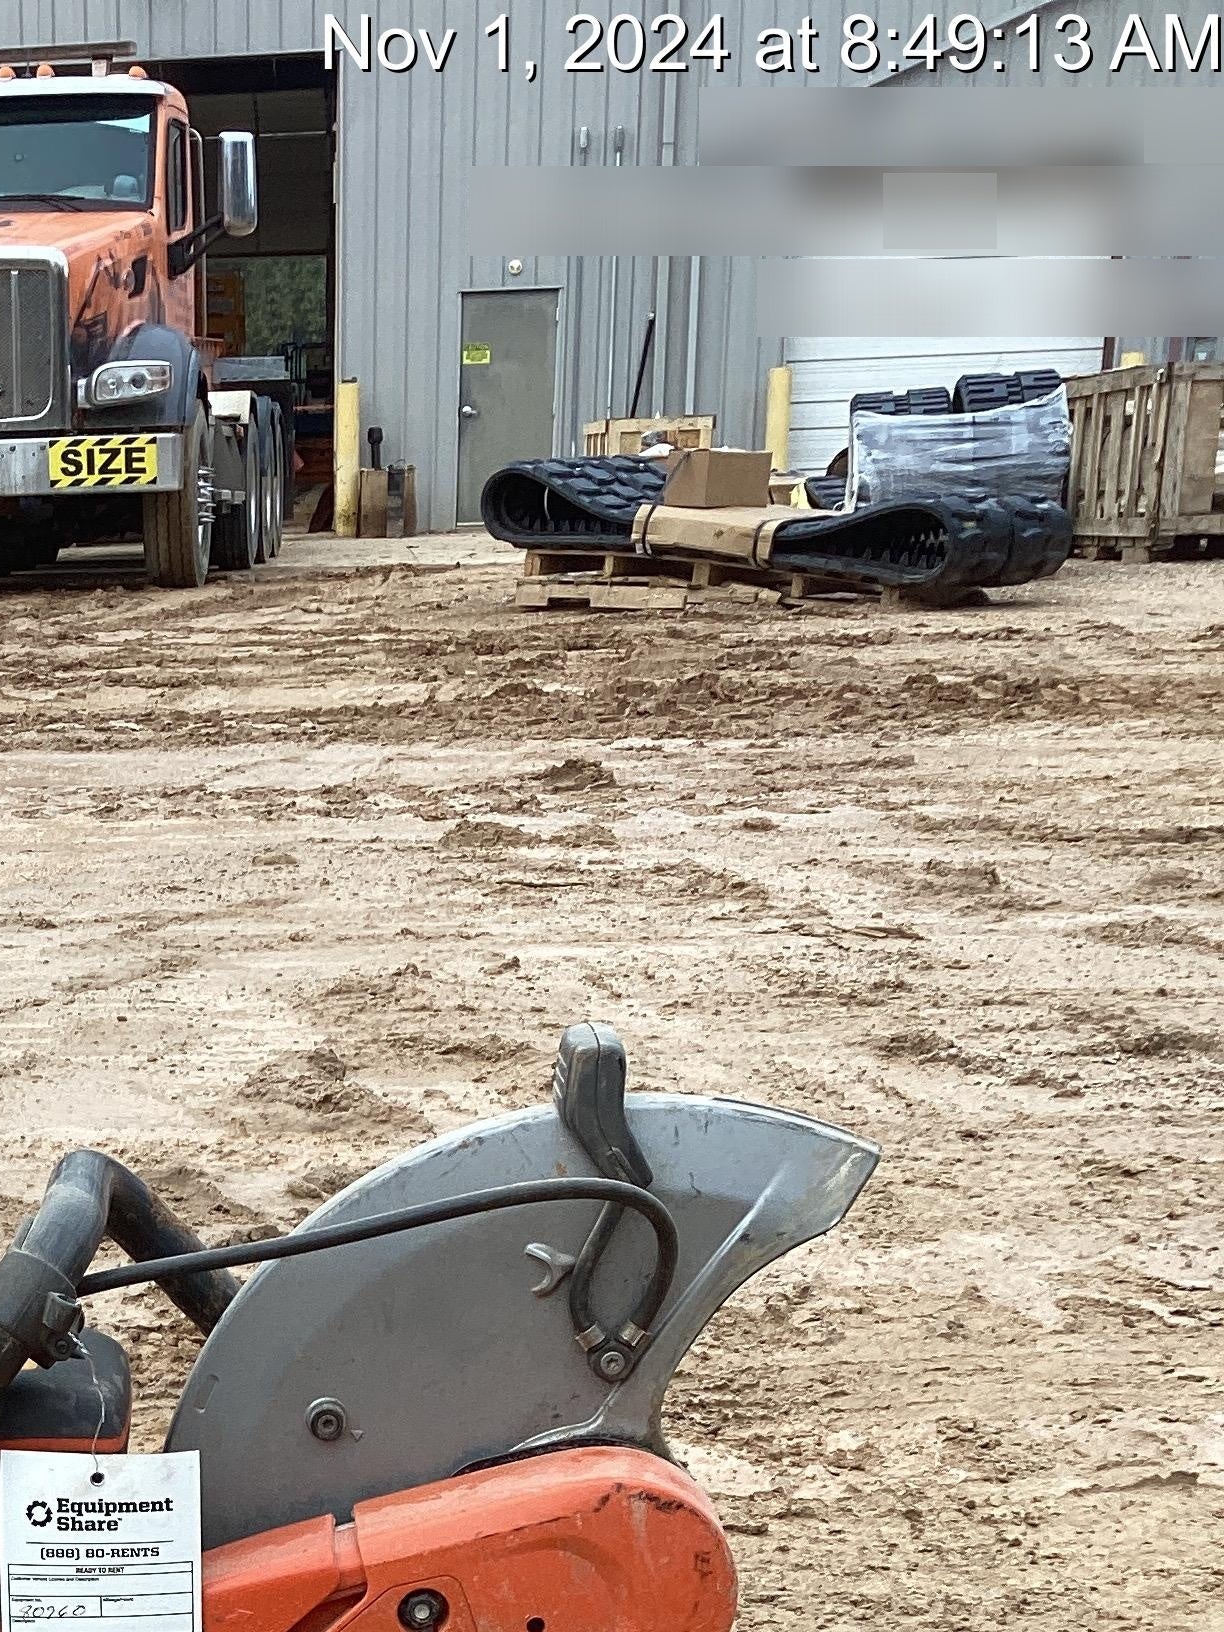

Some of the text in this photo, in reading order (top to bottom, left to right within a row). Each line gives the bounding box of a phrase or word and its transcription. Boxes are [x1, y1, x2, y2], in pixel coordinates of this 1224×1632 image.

[60, 446, 147, 477] SIZE
[56, 1497, 174, 1517] Equipment
[56, 1516, 119, 1532] Share
[40, 1546, 160, 1560] (888) 80-RENTS
